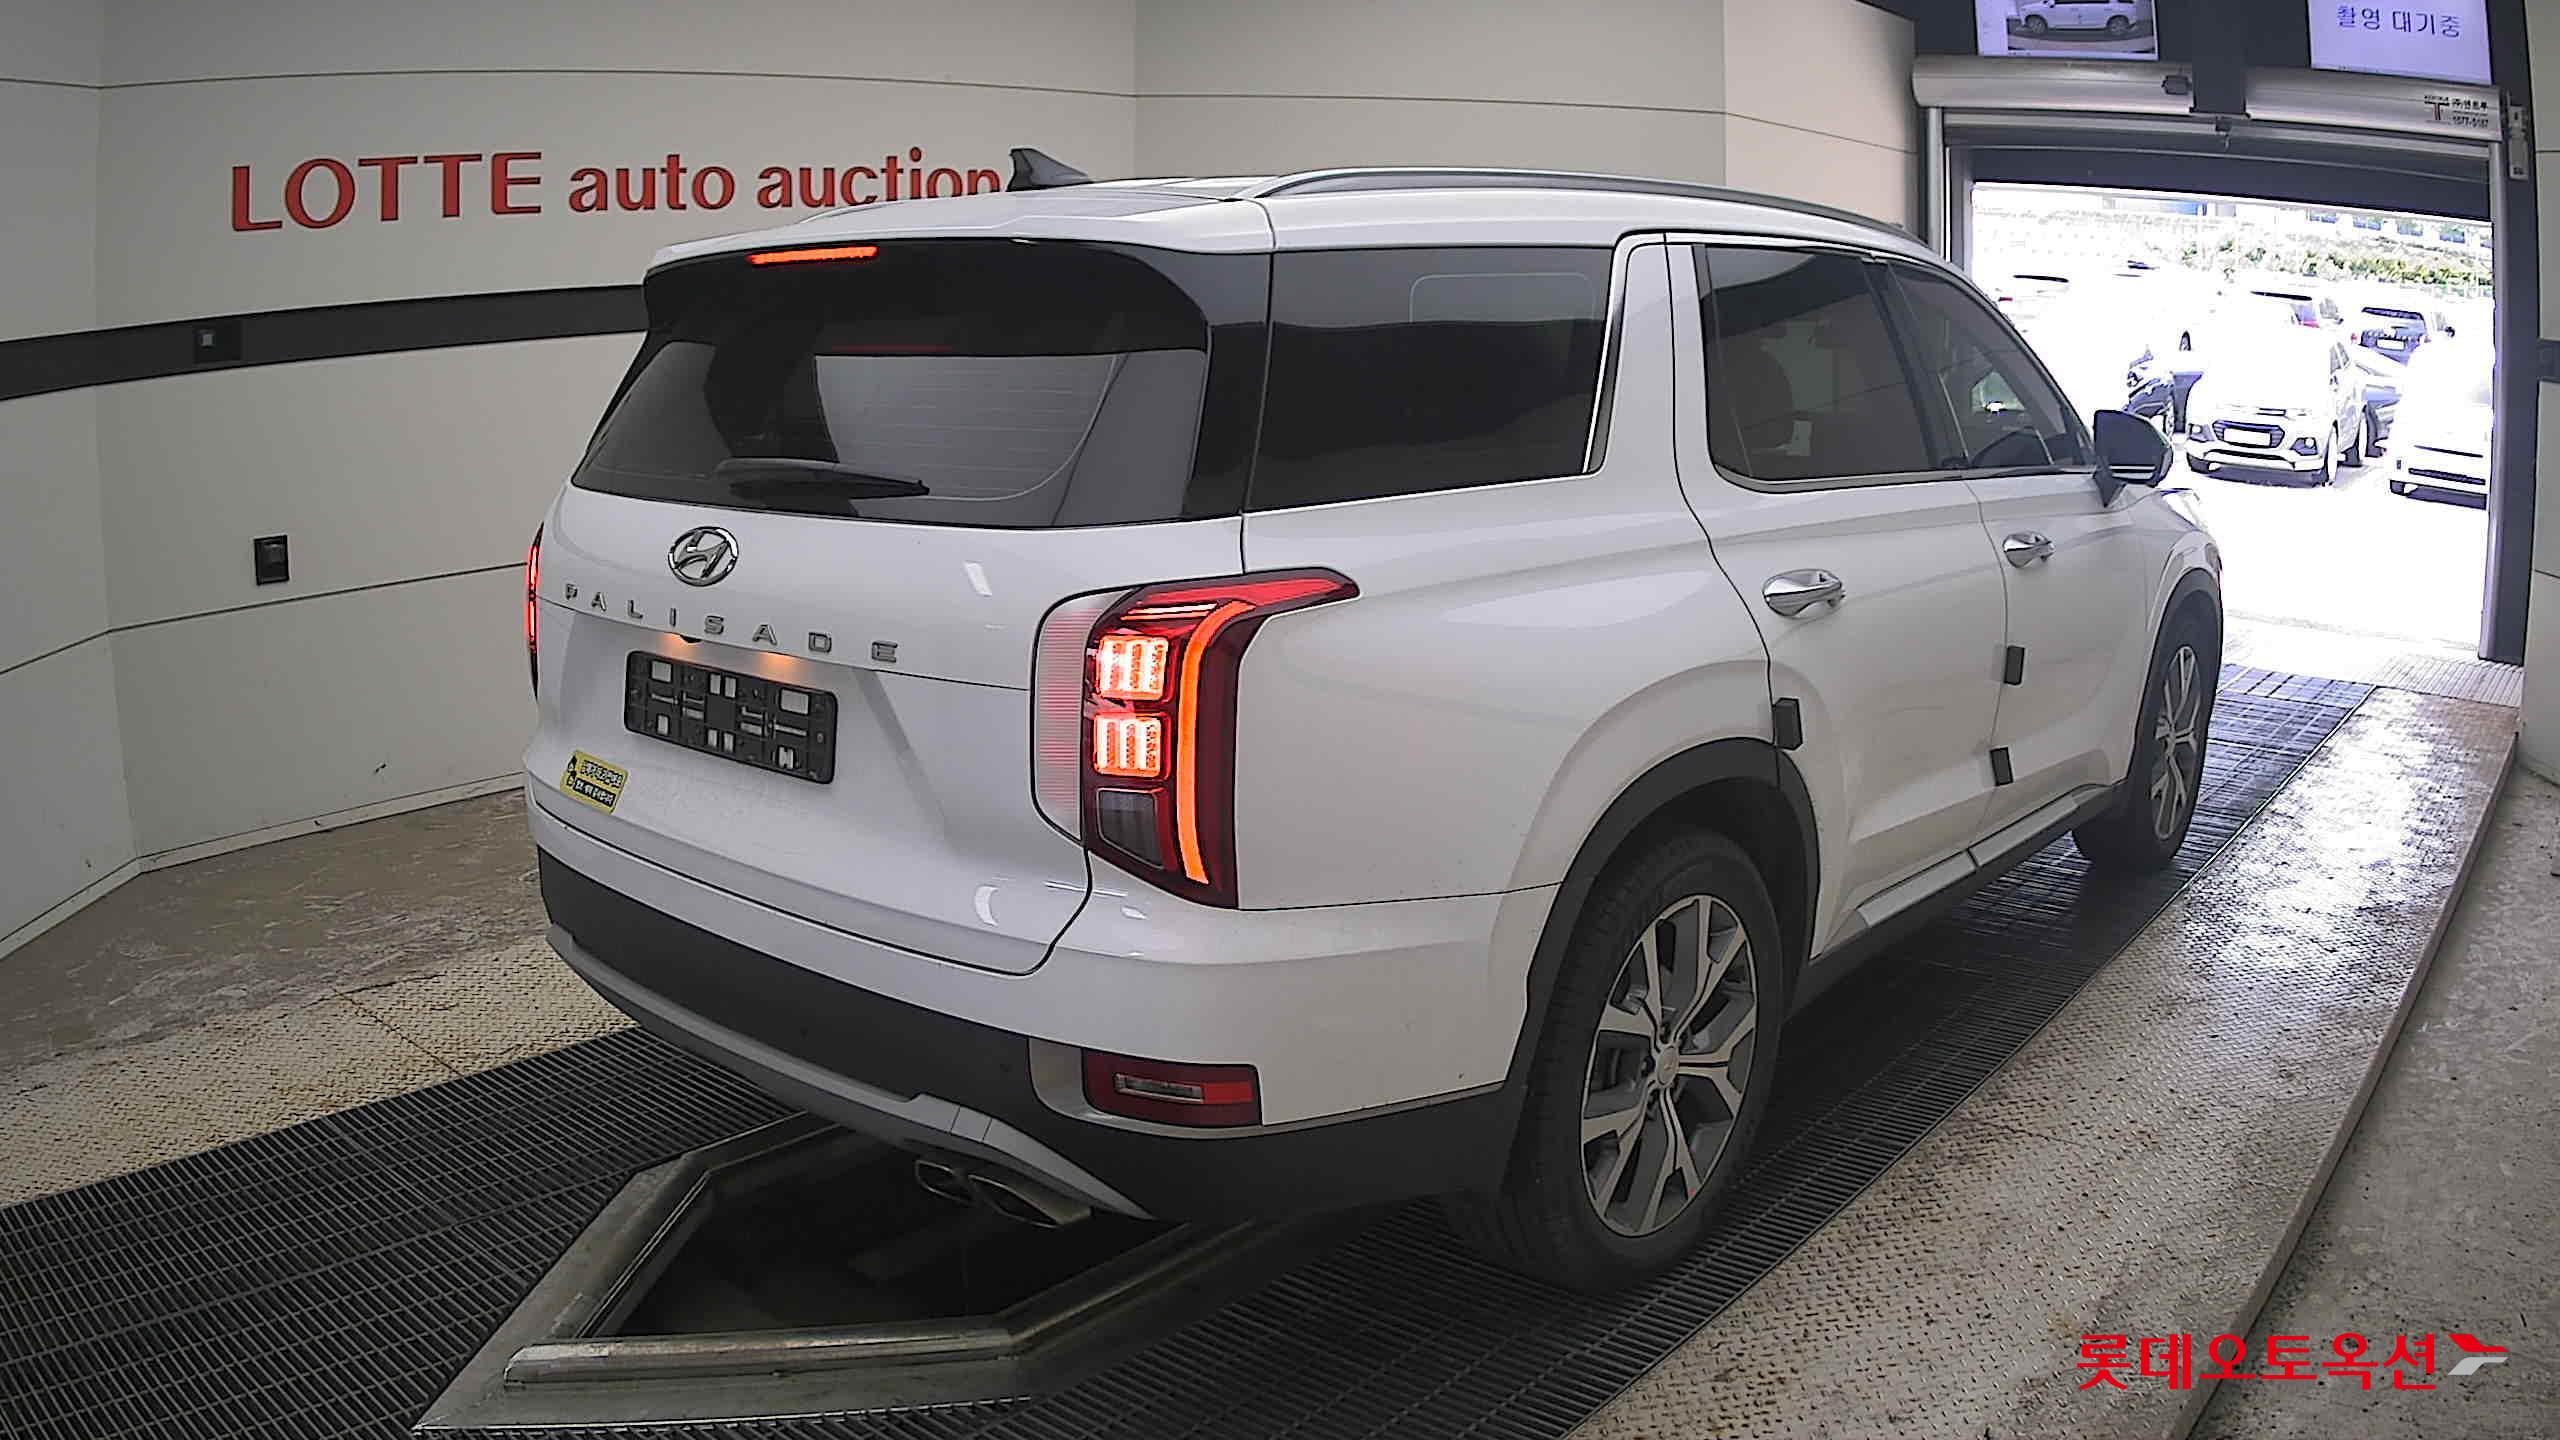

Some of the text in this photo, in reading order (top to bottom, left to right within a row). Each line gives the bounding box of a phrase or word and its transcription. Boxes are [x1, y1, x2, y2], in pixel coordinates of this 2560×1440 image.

[2337, 5, 2460, 38] 촬영 대기중
[232, 146, 1002, 232] LOTTE auto auction
[565, 584, 898, 663] PALISADE
